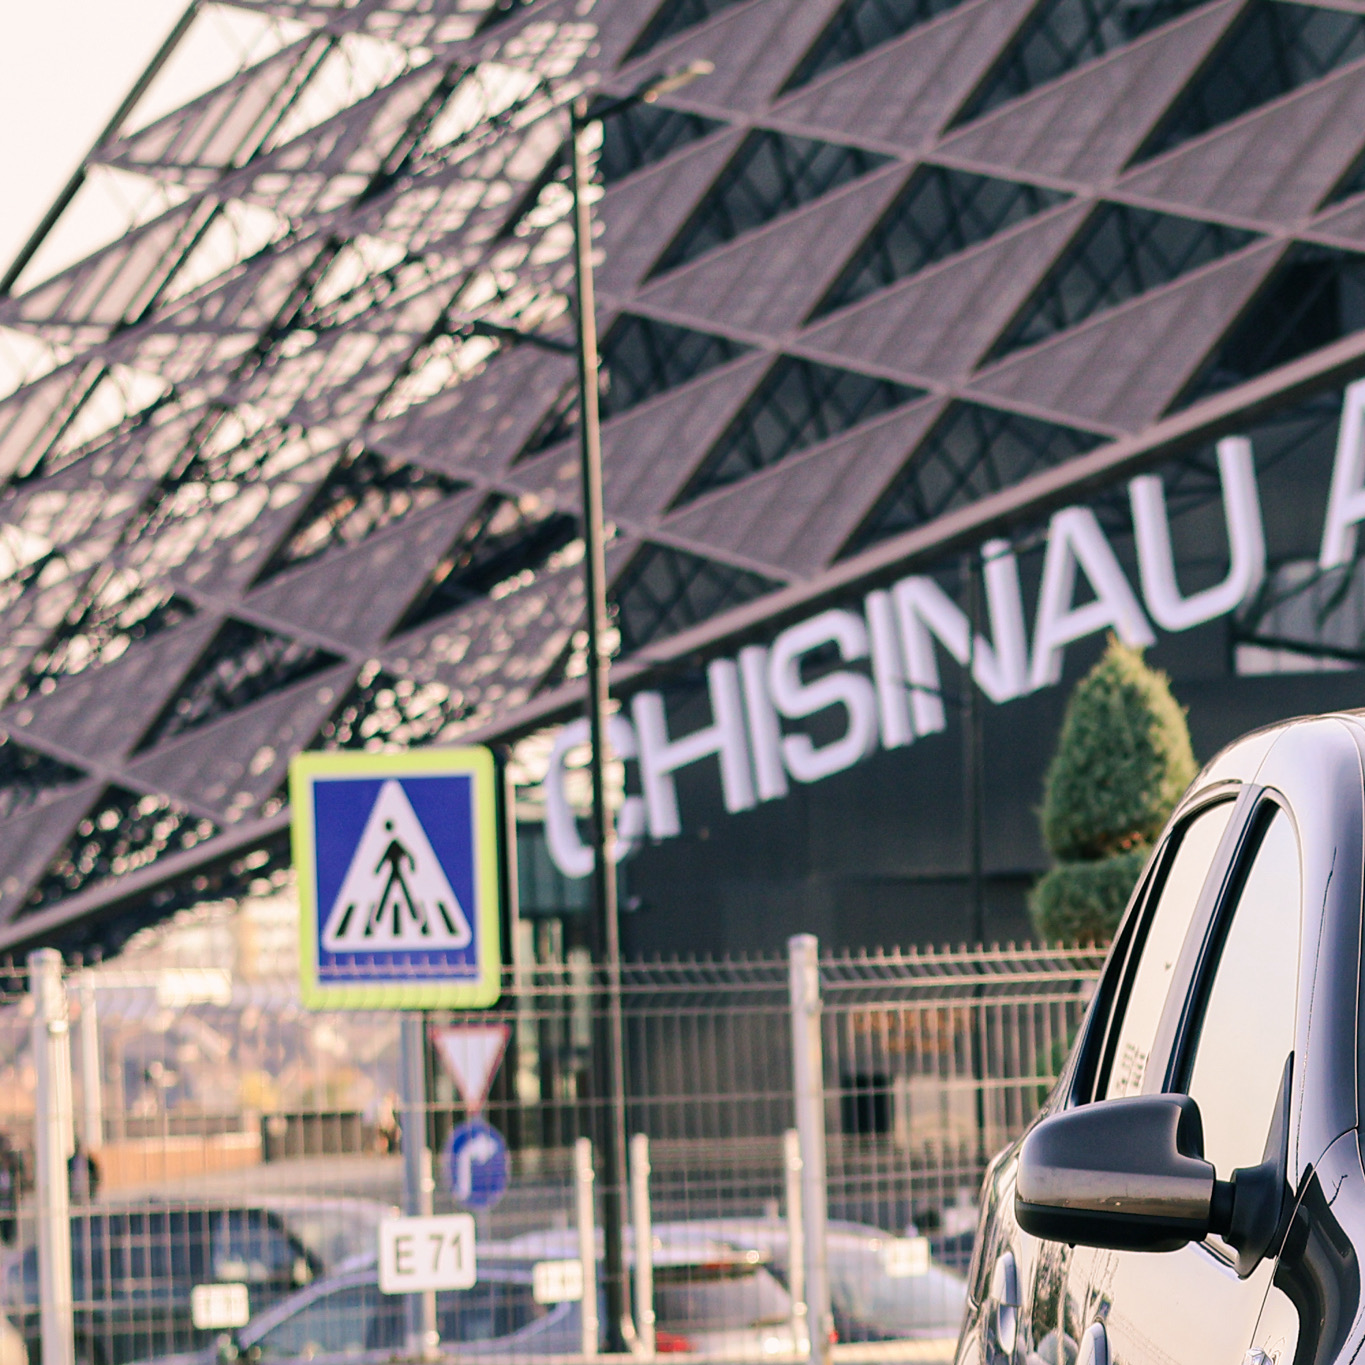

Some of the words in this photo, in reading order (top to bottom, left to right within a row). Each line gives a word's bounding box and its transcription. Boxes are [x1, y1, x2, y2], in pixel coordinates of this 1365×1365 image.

[544, 436, 1266, 878] CHISINAU
[394, 1234, 415, 1275] E
[429, 1233, 463, 1273] 71
